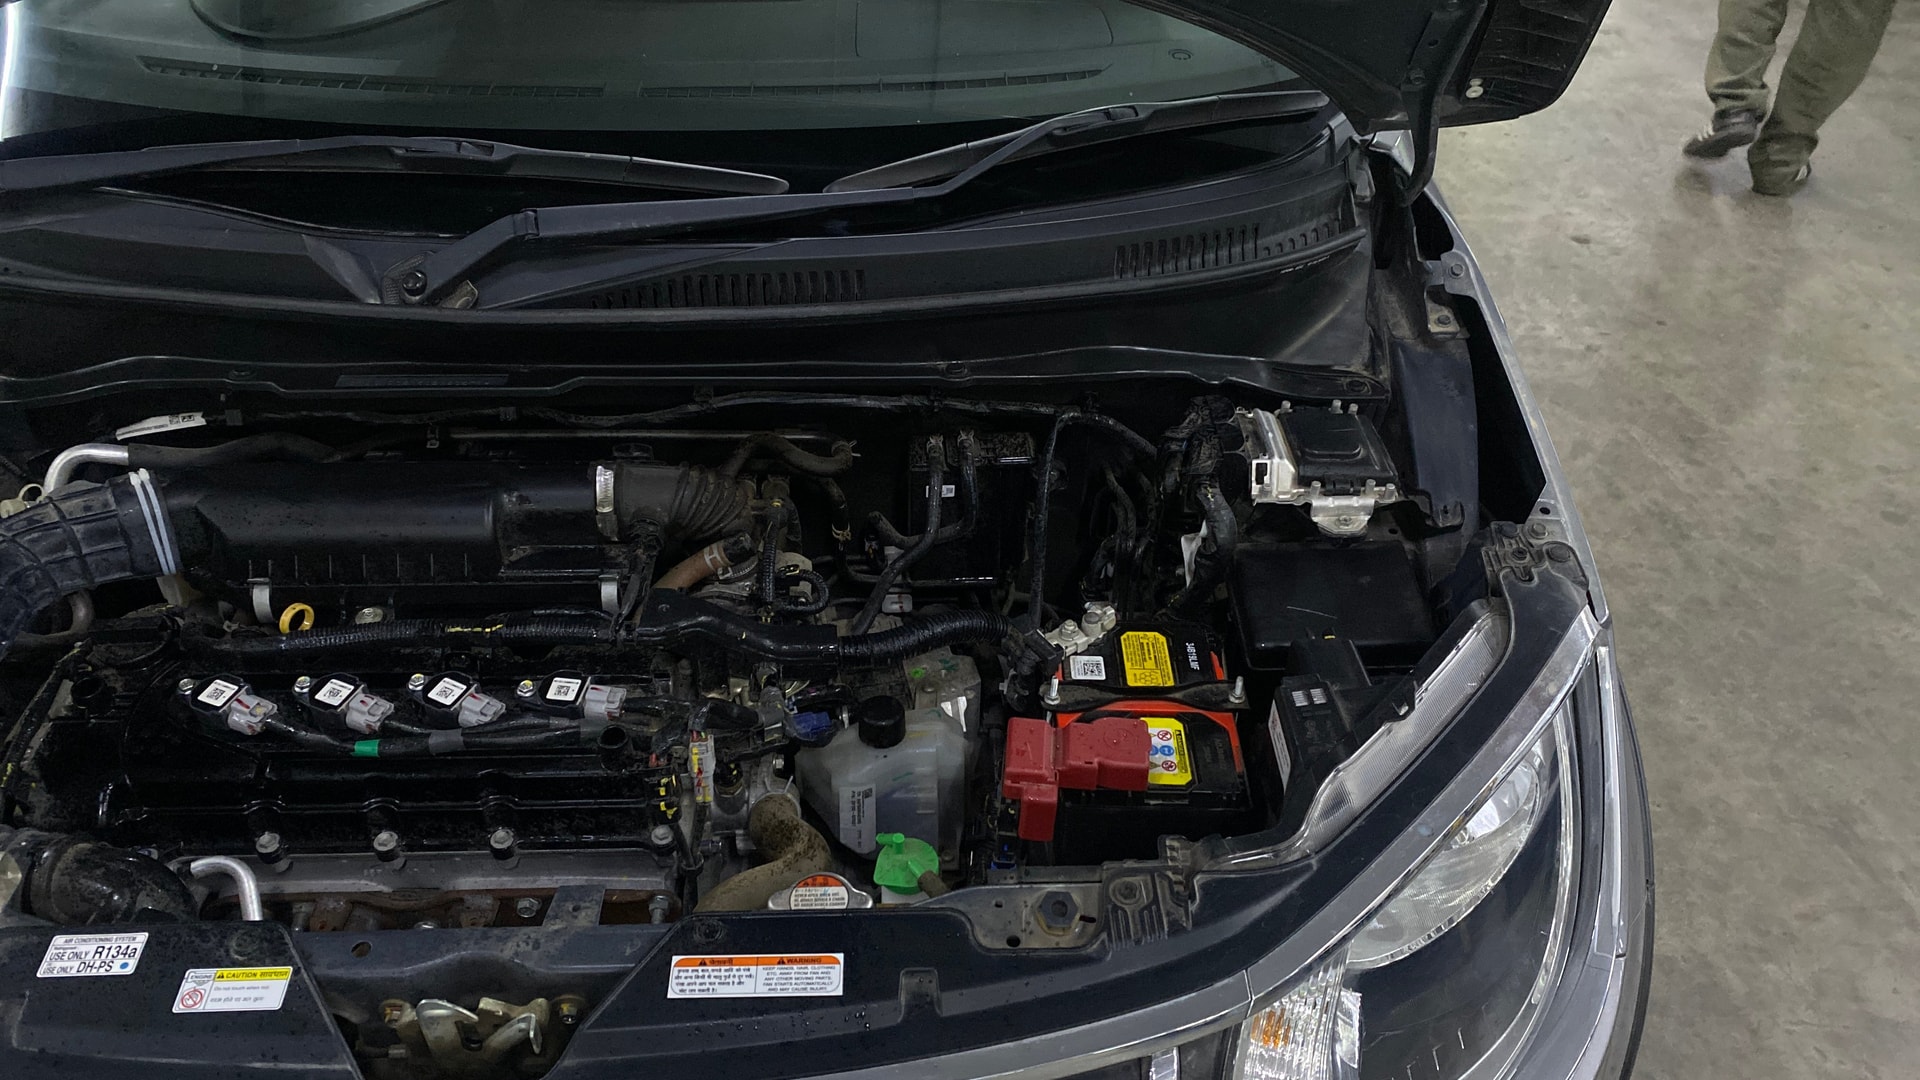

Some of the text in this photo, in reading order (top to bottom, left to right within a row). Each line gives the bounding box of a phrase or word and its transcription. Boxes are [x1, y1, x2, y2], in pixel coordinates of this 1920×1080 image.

[49, 945, 138, 961] USE ONLY R134a
[43, 961, 114, 974] USE ONLY DH-PS
[226, 971, 258, 979] CAUTION
